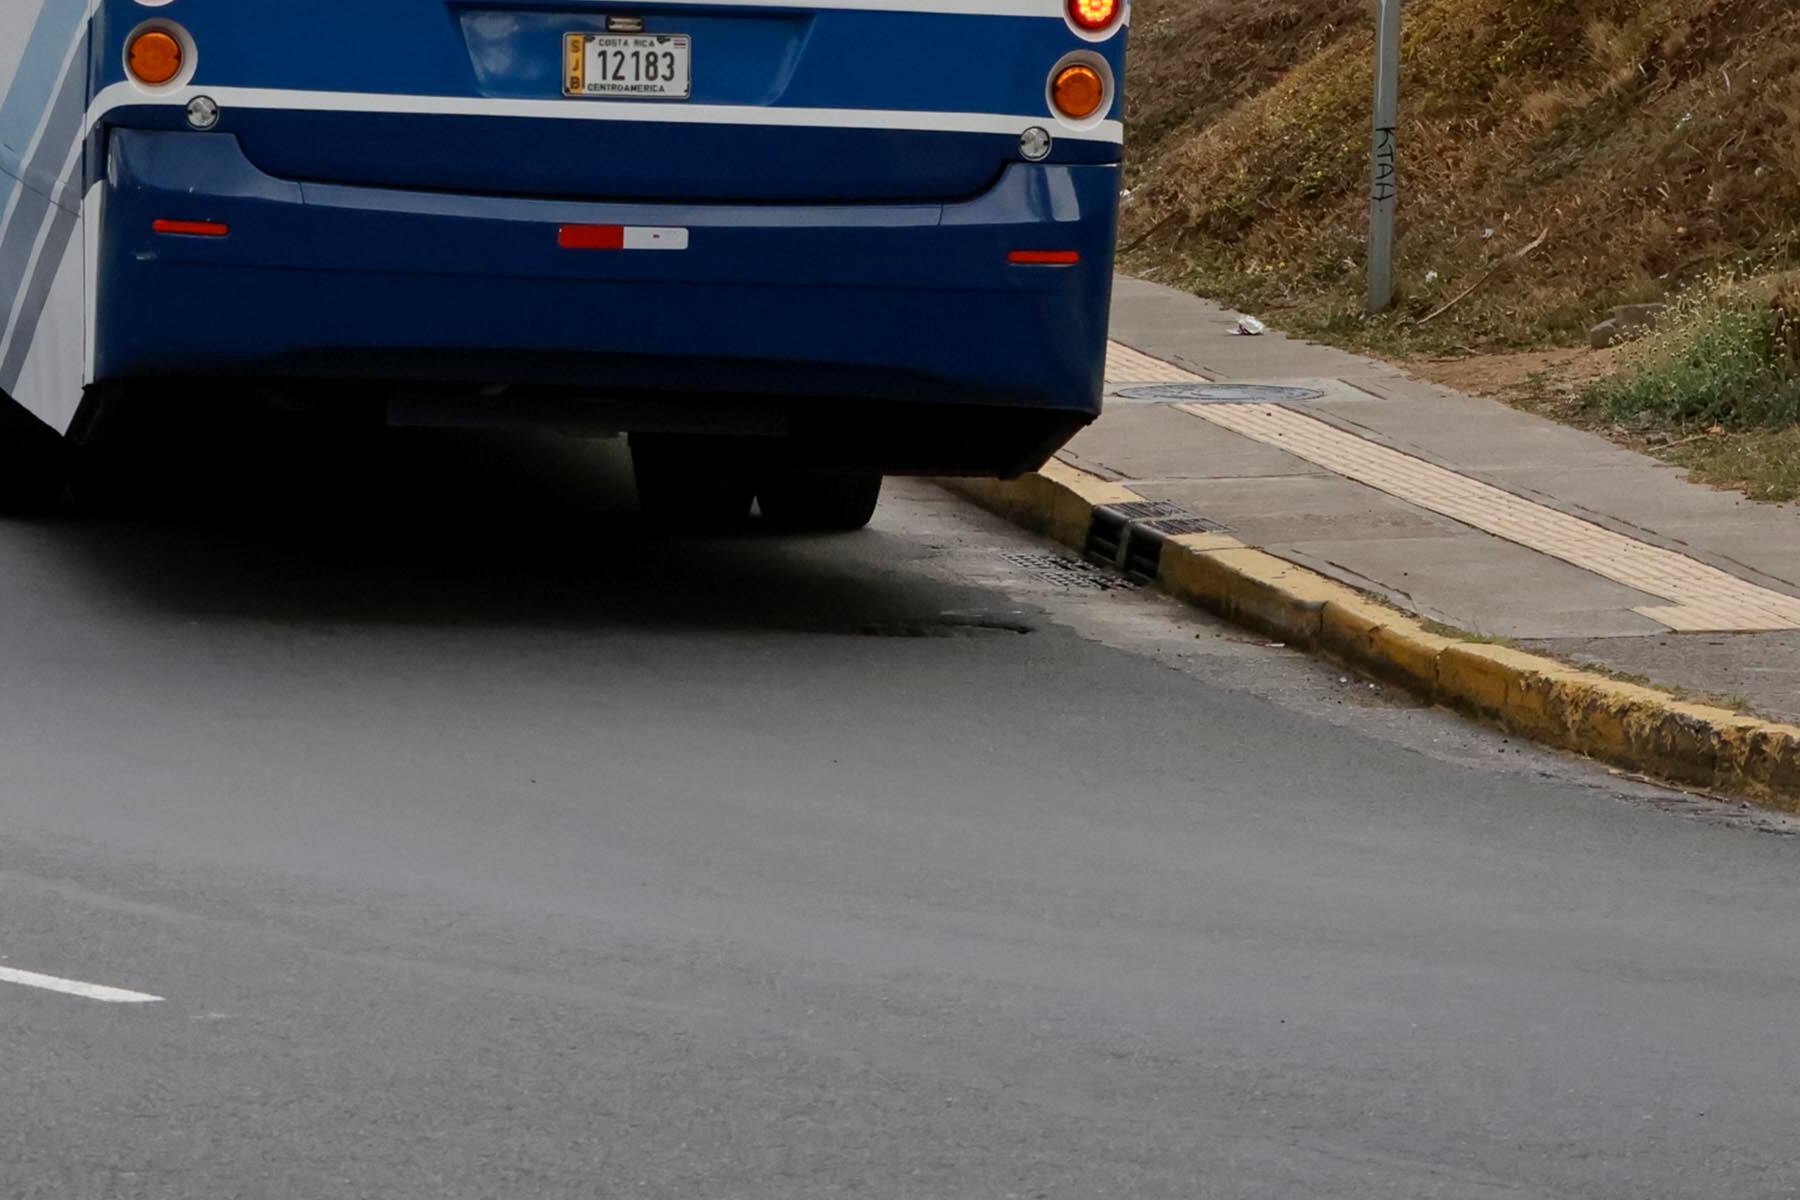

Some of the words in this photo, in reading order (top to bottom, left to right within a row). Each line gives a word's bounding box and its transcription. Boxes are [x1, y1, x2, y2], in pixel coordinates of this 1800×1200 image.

[598, 39, 629, 47] COSTA
[633, 39, 655, 47] RICA
[597, 49, 675, 82] 12183
[587, 82, 665, 93] CENTROAMERICA
